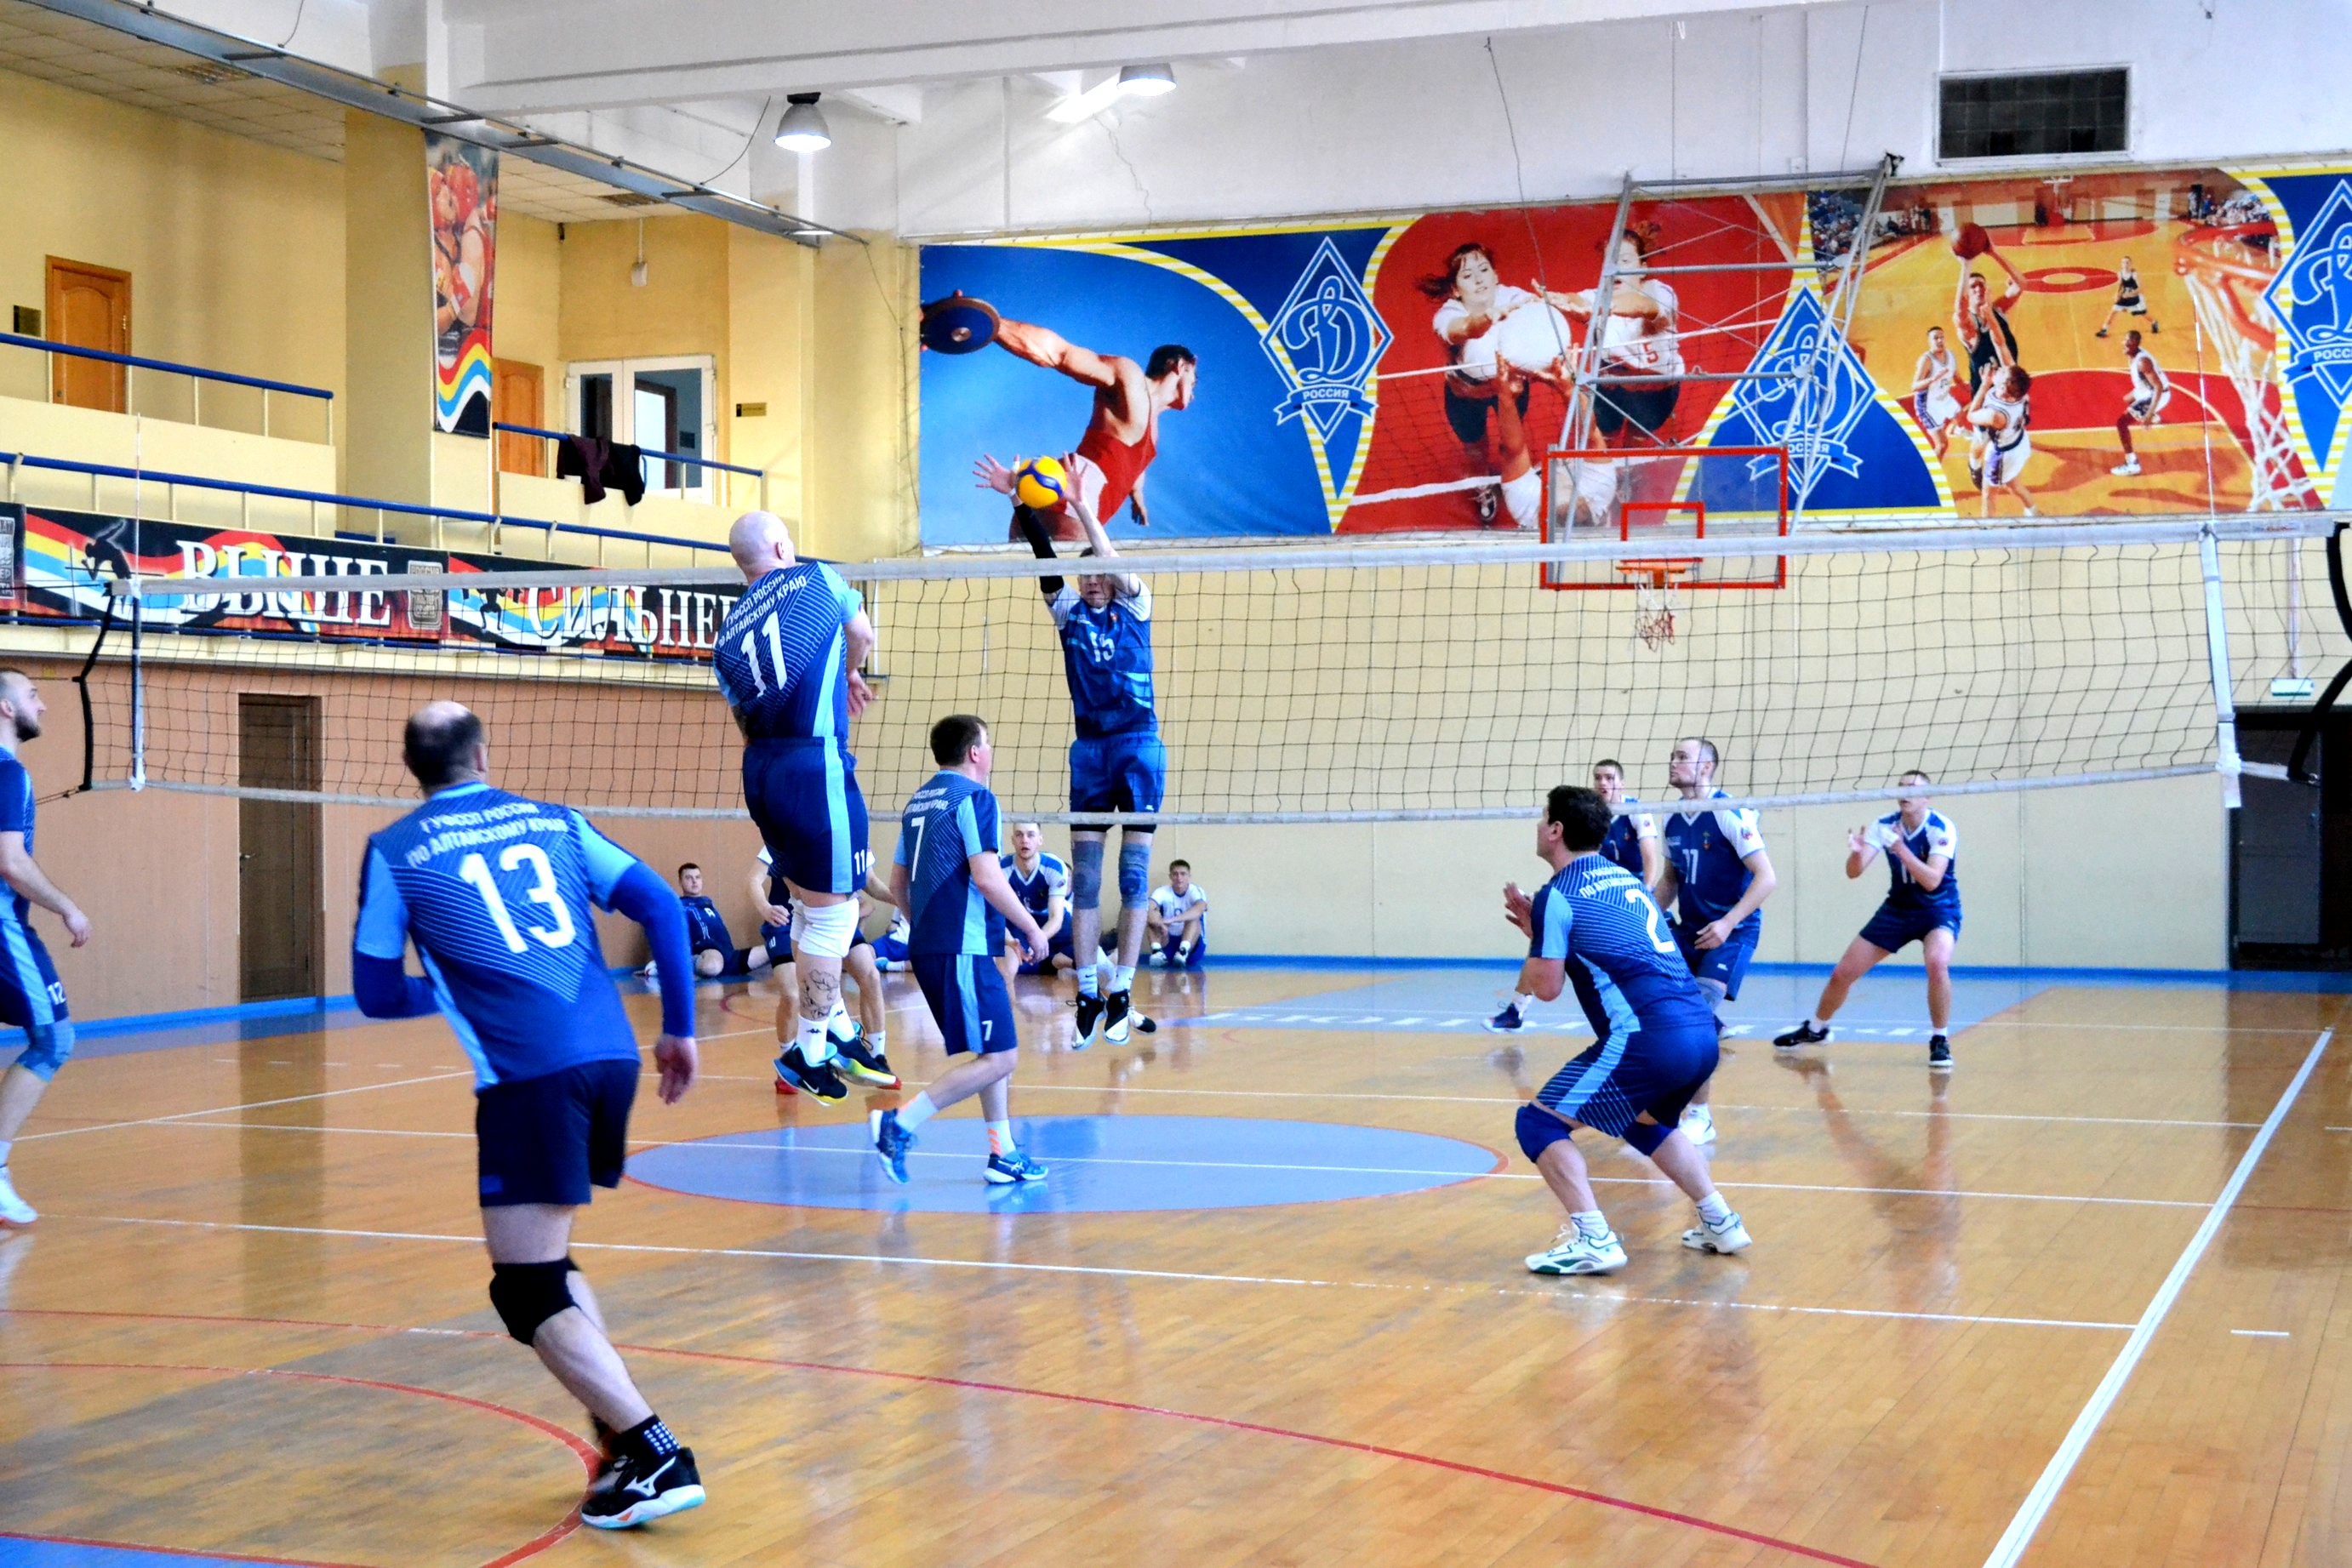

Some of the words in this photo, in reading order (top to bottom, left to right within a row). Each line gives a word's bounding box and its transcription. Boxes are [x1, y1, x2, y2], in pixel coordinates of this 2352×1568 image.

[2314, 348, 2352, 362] РОСС
[1303, 389, 1350, 400] РОССИЯ
[1787, 442, 1830, 454] ОССЯ
[726, 596, 754, 628] ГУФССП
[752, 573, 785, 603] РОССИИ
[726, 594, 775, 641] АЛТАЙСКОМУ
[776, 575, 807, 601] КРАЮ
[740, 611, 788, 698] 11
[1090, 631, 1115, 662] 15
[854, 849, 865, 875] 11
[911, 816, 925, 882] 7
[459, 843, 576, 954] 13
[1625, 888, 1676, 953] 2
[48, 981, 66, 1005] 12
[981, 1020, 993, 1041] 7
